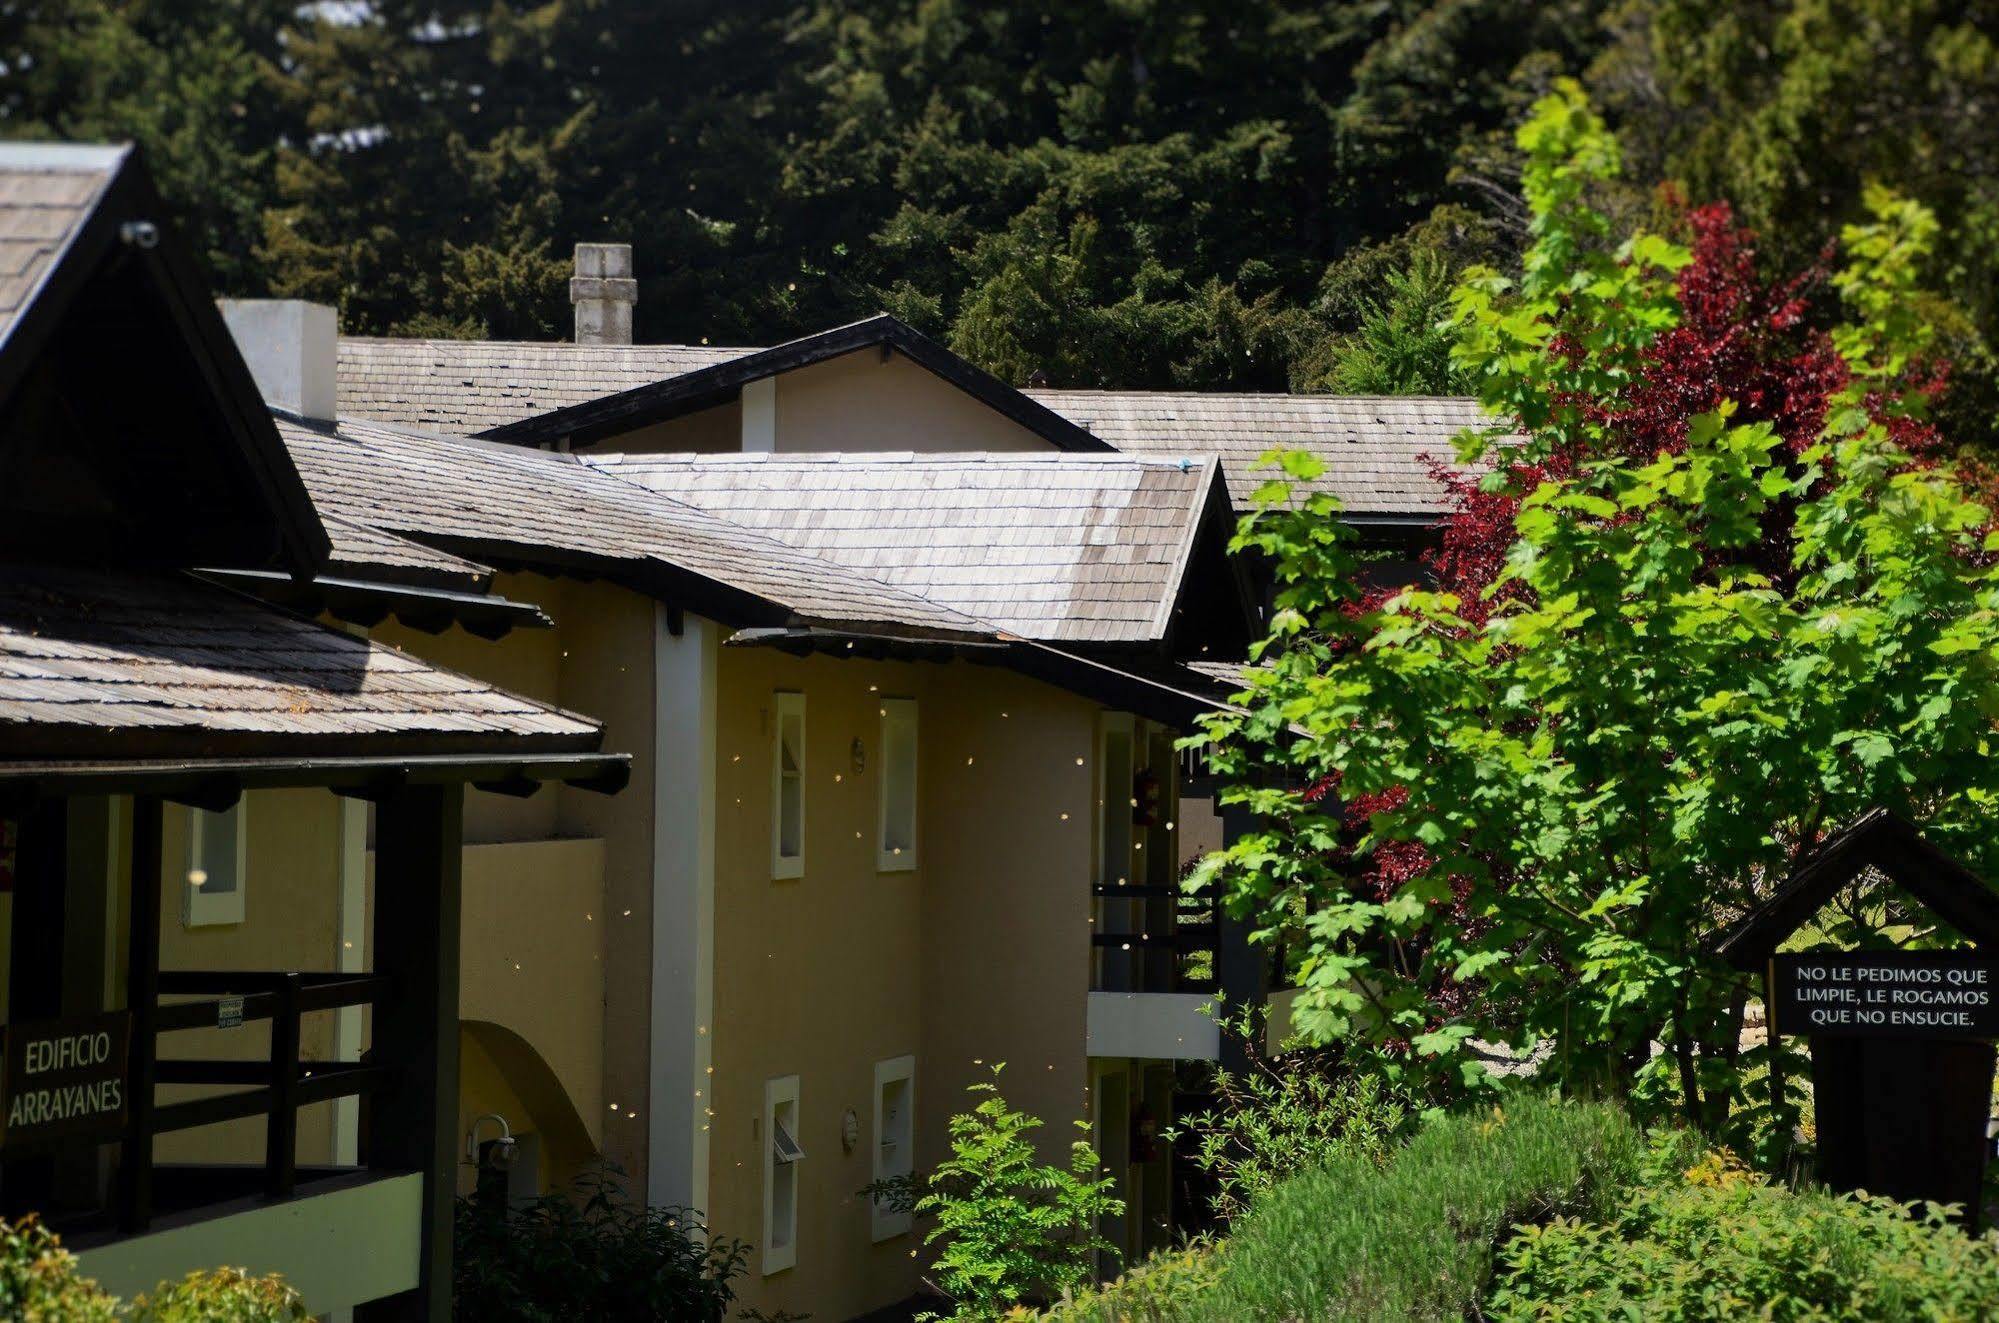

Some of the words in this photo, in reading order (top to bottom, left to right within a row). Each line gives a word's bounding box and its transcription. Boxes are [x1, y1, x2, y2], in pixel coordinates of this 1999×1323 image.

[1797, 967, 1826, 981] NO
[1832, 967, 1851, 982] LE
[1857, 968, 1942, 983] PEDIMOS
[1947, 969, 1988, 986] QUE
[1797, 988, 1861, 1005] LIMPIE,
[1867, 989, 1887, 1003] LE
[1893, 990, 1989, 1005] ROGAMOS
[1811, 1009, 1850, 1025] QUE
[1856, 1010, 1885, 1024] NO
[1891, 1011, 1975, 1026] ENSUCIE.
[25, 1031, 110, 1074] EDIFICIO
[8, 1078, 121, 1128] ARRAYANES
